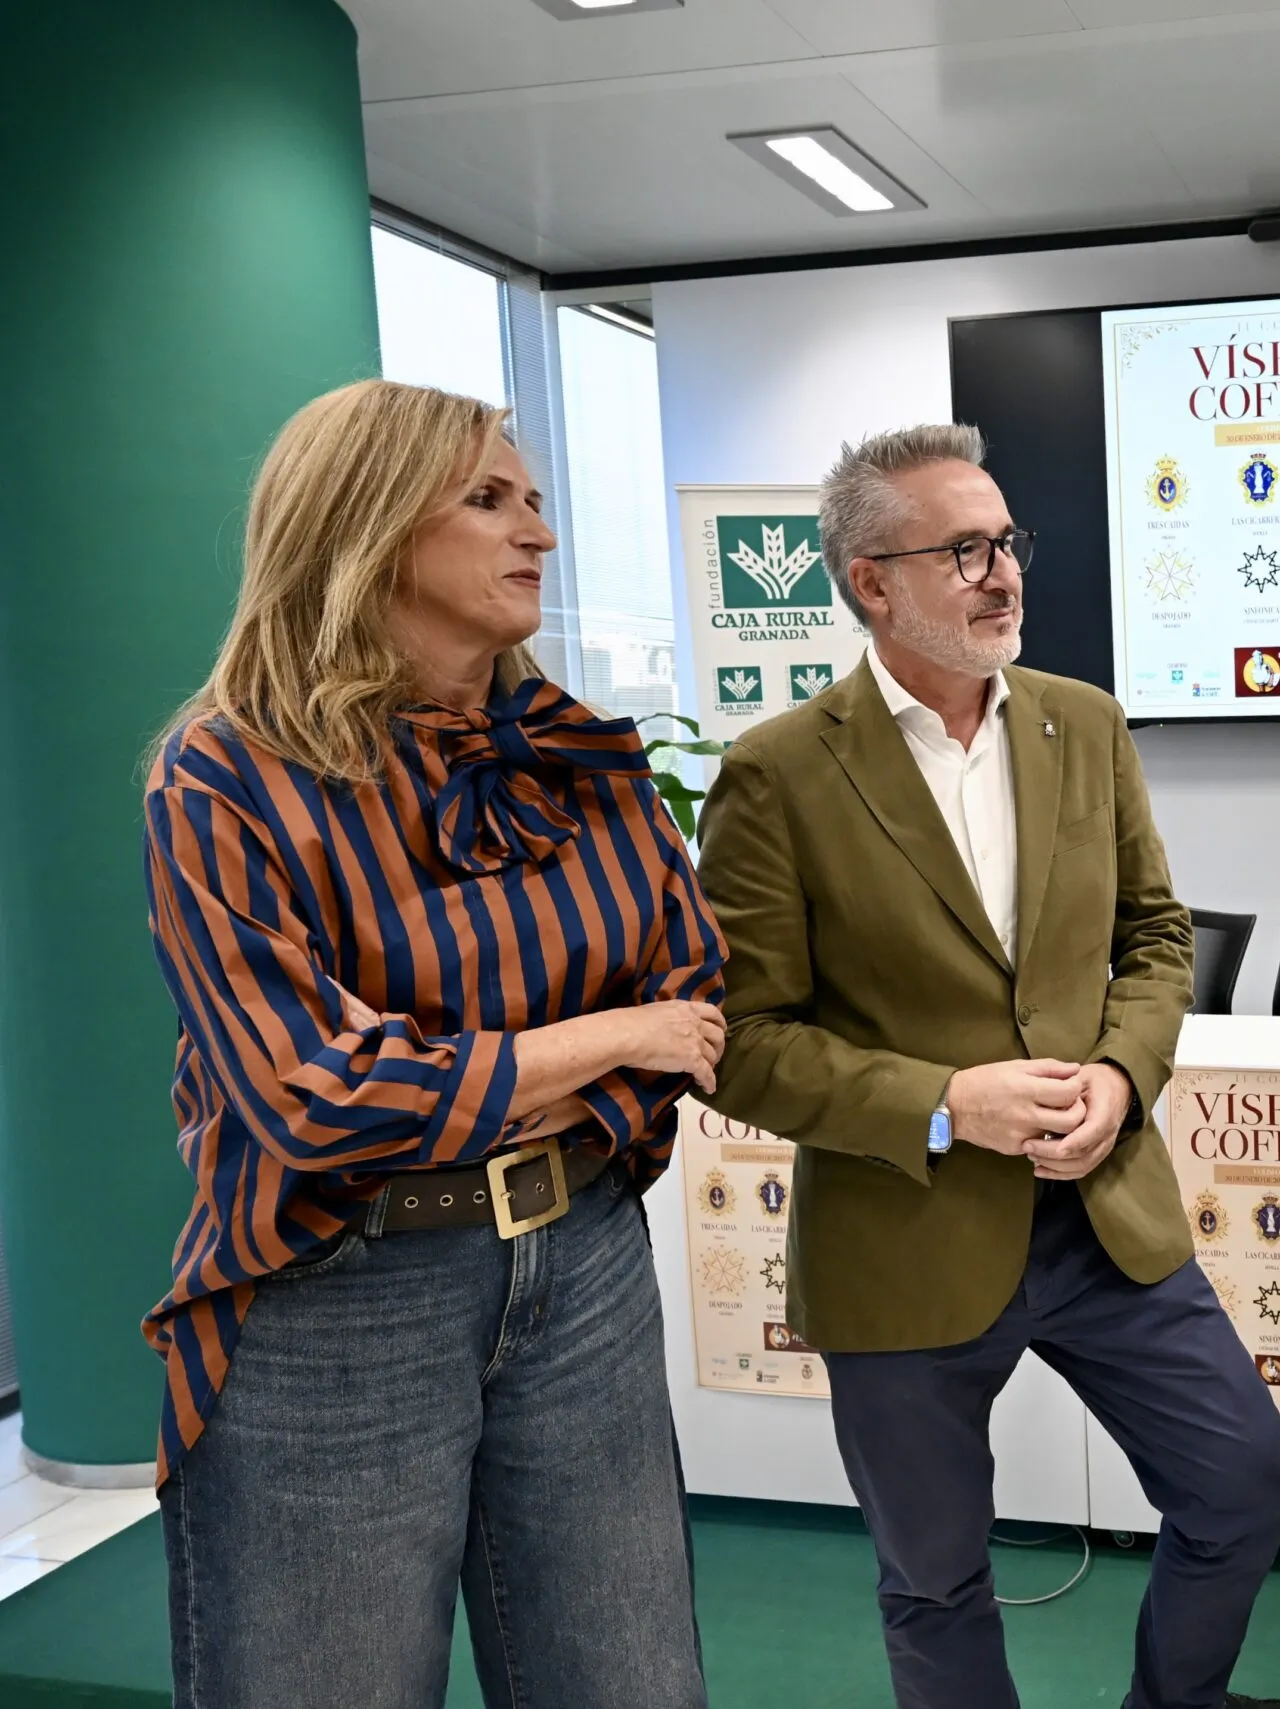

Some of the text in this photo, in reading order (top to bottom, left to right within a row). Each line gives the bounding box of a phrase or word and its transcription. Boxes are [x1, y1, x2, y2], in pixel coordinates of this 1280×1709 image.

[702, 519, 721, 608] fundación
[711, 611, 835, 629] CAJA RURAL
[738, 629, 810, 642] GRANADA
[715, 704, 734, 712] CAJA
[1245, 1251, 1257, 1260] LAS
